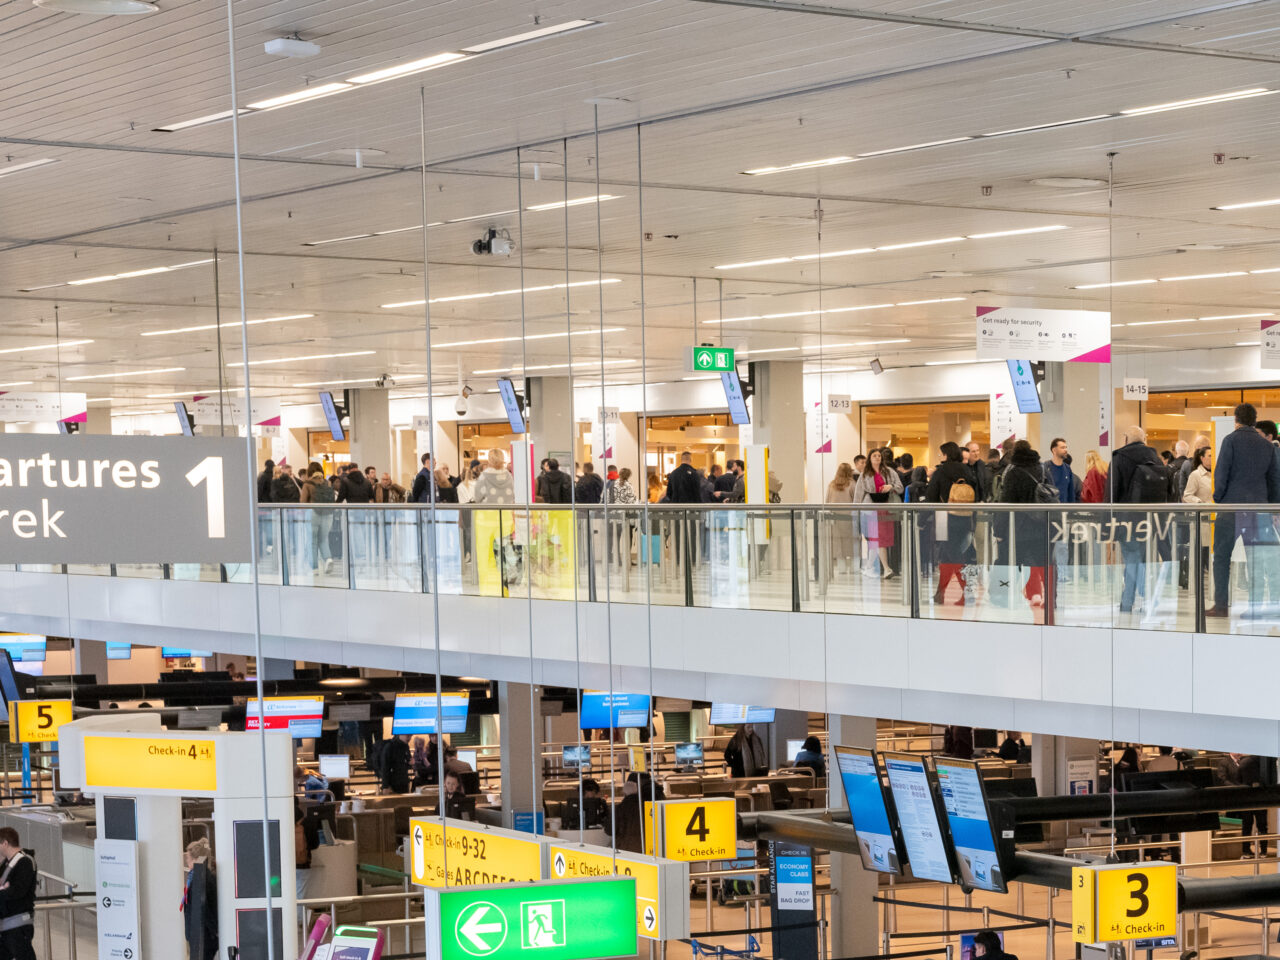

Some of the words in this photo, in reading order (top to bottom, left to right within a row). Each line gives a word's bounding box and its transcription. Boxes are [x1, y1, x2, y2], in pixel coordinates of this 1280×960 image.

[993, 317, 1010, 325] ready
[1020, 319, 1042, 327] security
[1125, 385, 1147, 394] 14-15
[830, 400, 850, 408] 12-13
[185, 456, 226, 539] 1
[37, 705, 53, 729] 5
[148, 744, 186, 756] Check-in
[188, 744, 197, 760] 4
[685, 806, 710, 842] 4
[461, 836, 487, 860] 9-32
[690, 847, 726, 857] Check-in
[1078, 875, 1084, 888] 3
[1126, 872, 1149, 918] 3
[1125, 922, 1165, 935] Check-in
